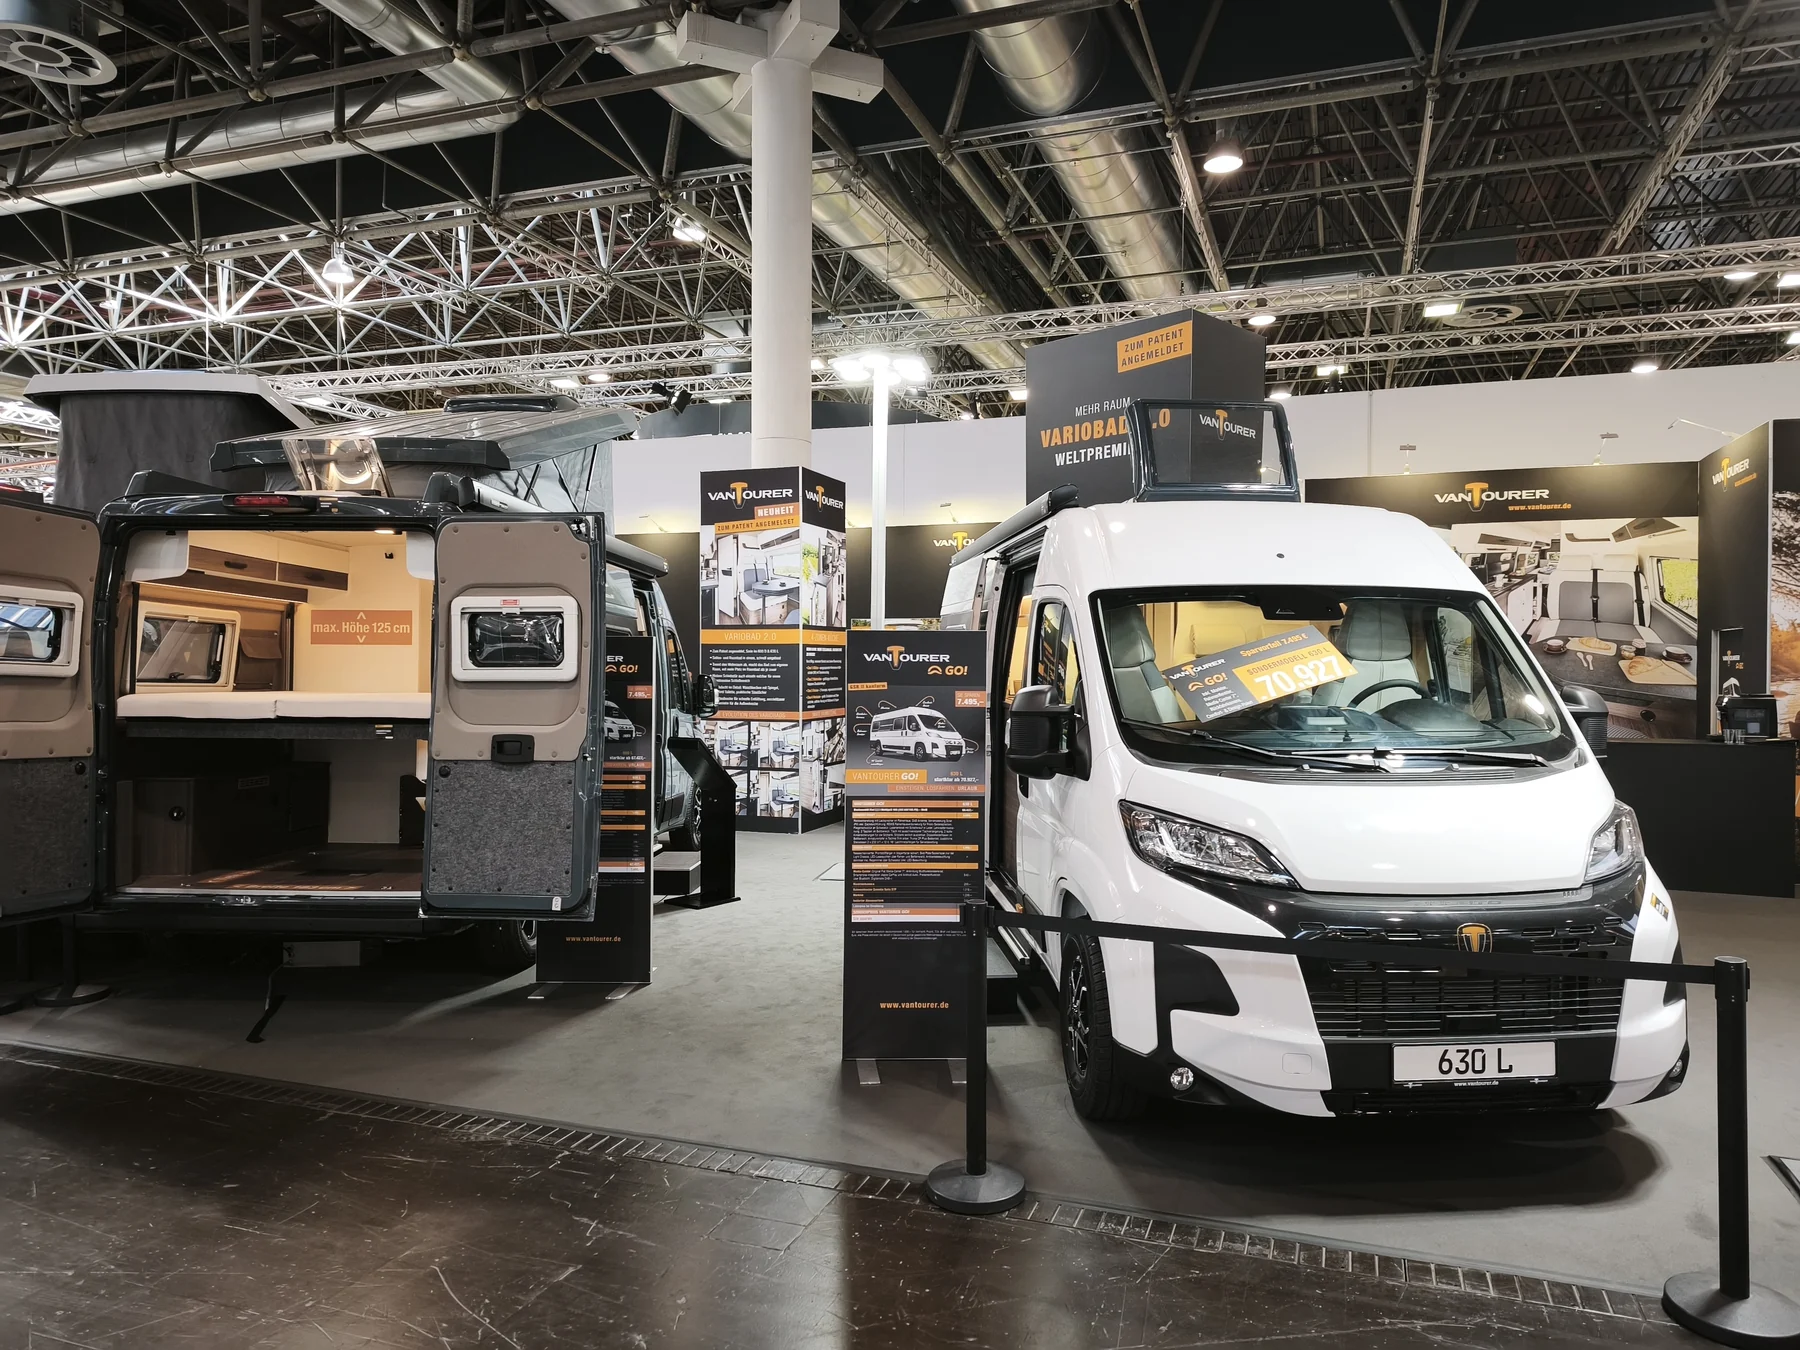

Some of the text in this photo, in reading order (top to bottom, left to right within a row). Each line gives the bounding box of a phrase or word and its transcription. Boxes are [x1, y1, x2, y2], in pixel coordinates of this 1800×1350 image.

[1124, 328, 1184, 352] ZUM PATENT
[1121, 342, 1184, 367] ANGEMELDET
[1075, 396, 1131, 418] MEHR RAUM
[1040, 416, 1128, 448] VARIOBAD
[1200, 409, 1256, 439] VANTOURER
[1055, 442, 1131, 466] WELTPREMI
[1712, 458, 1750, 488] VANTOURER
[708, 482, 793, 505] VANTOURER
[805, 486, 844, 510] VANTOURER
[1434, 482, 1550, 508] VANTOURER
[758, 506, 794, 516] NEUHEIT
[1508, 503, 1572, 511] www.vantourer.de
[756, 518, 794, 528] ANGEMELDET
[933, 532, 975, 550] VANTO
[312, 622, 410, 633] max. Höhe 125 cm
[724, 632, 776, 640] VARIOBAD 2.0
[864, 646, 950, 668] VANTOURER
[1247, 654, 1308, 675] SONDERMODELL
[1308, 648, 1323, 657] 630
[620, 664, 638, 673] GO!
[945, 666, 968, 676] GO!
[1170, 658, 1226, 680] VANTOURER
[1204, 672, 1228, 686] GO!
[1438, 1048, 1513, 1075] 630 L
